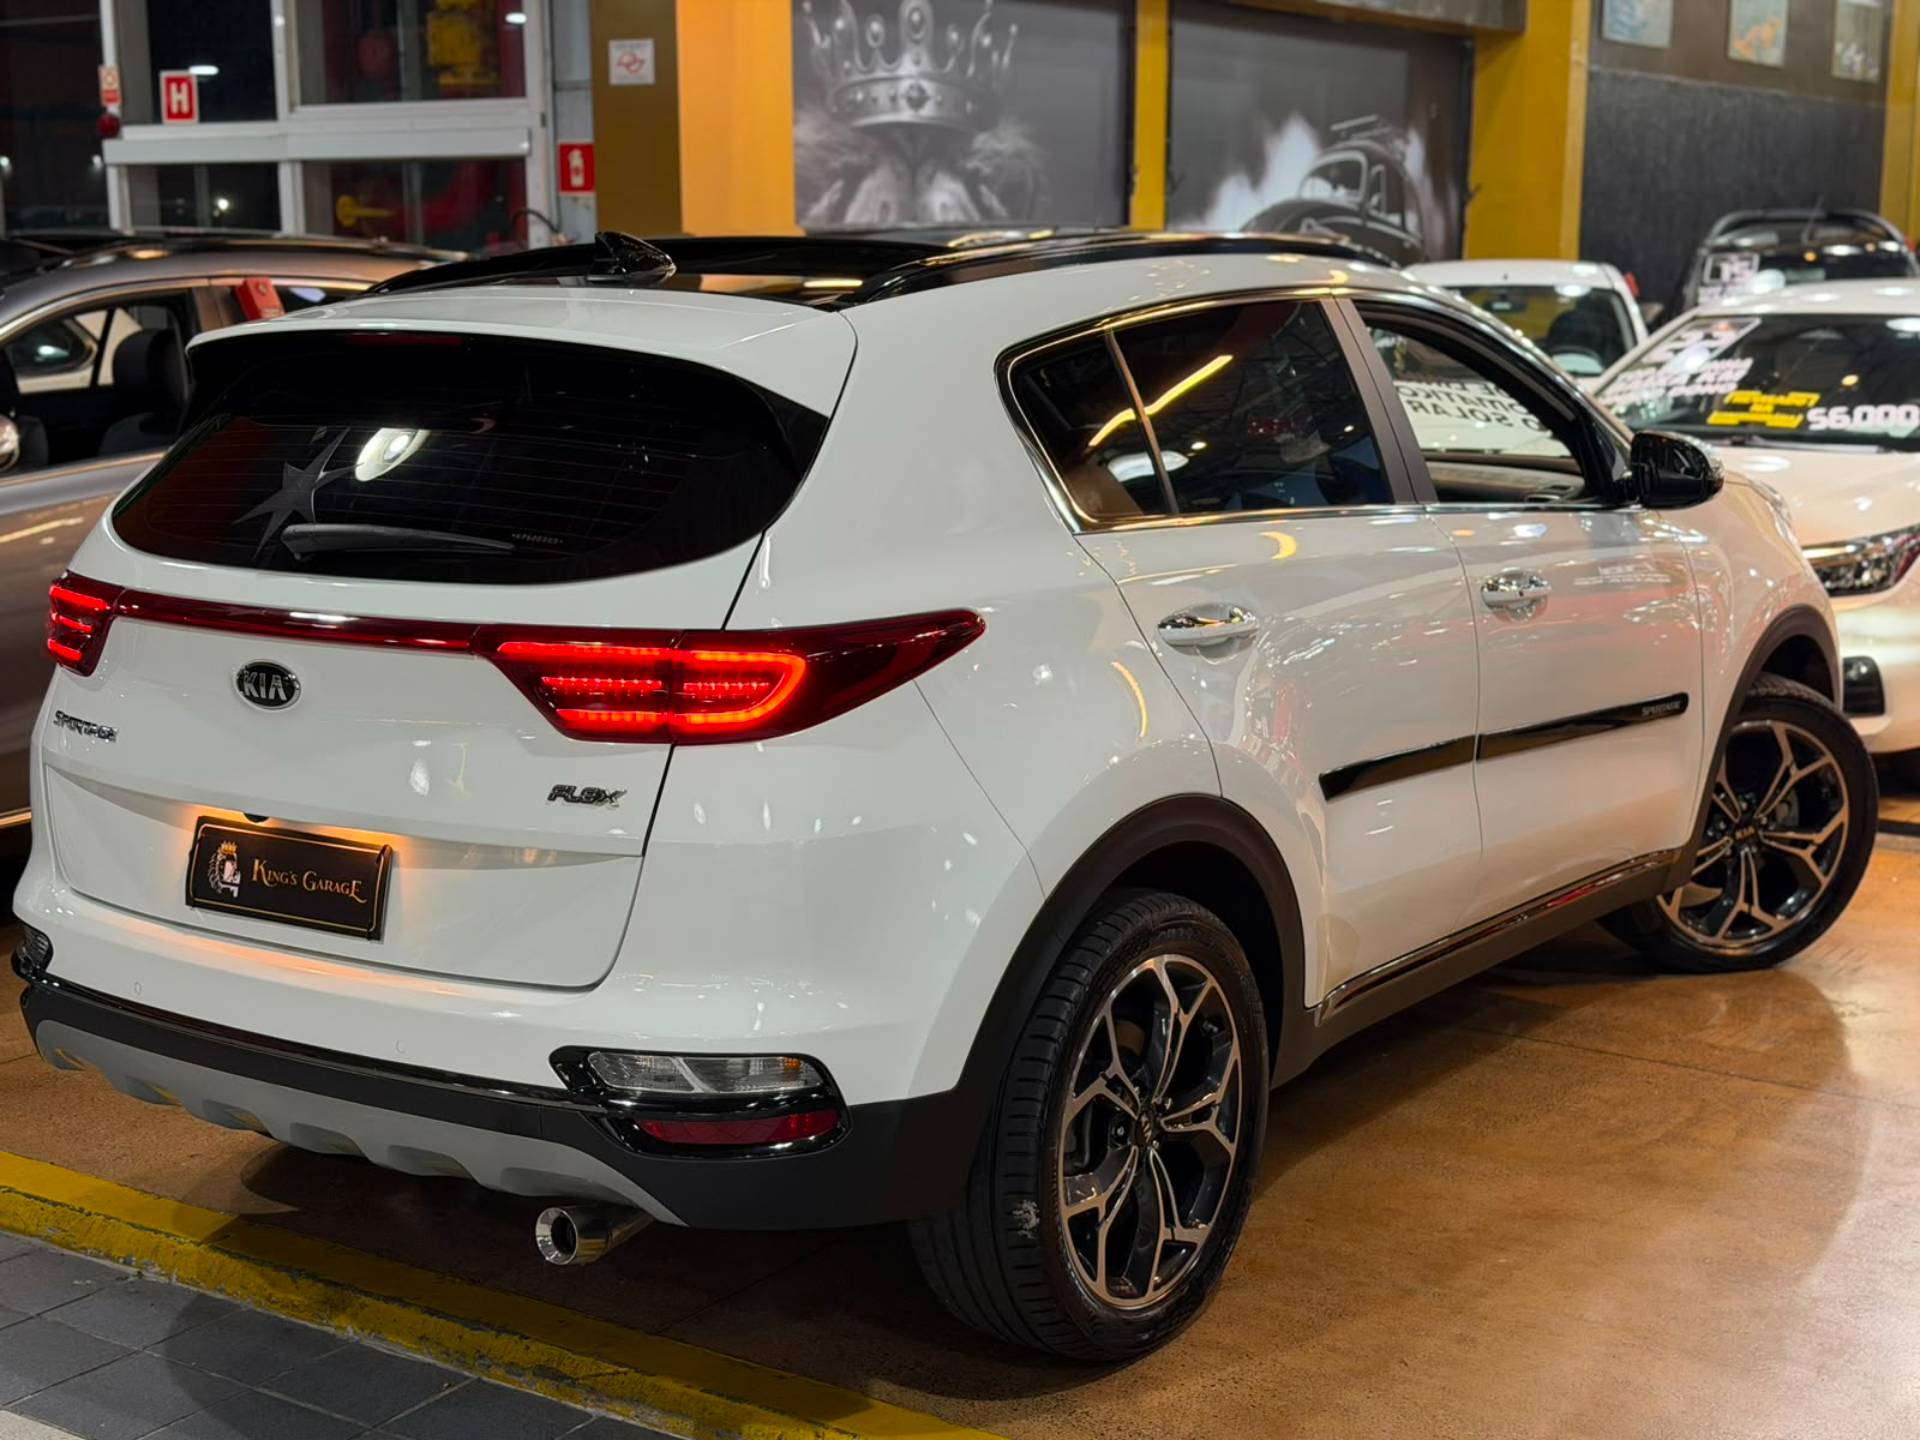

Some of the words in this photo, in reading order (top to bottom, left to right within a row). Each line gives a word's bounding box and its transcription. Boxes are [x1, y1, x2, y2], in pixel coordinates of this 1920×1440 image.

[170, 82, 190, 114] H
[242, 670, 288, 701] KIA
[547, 784, 627, 807] FLEX
